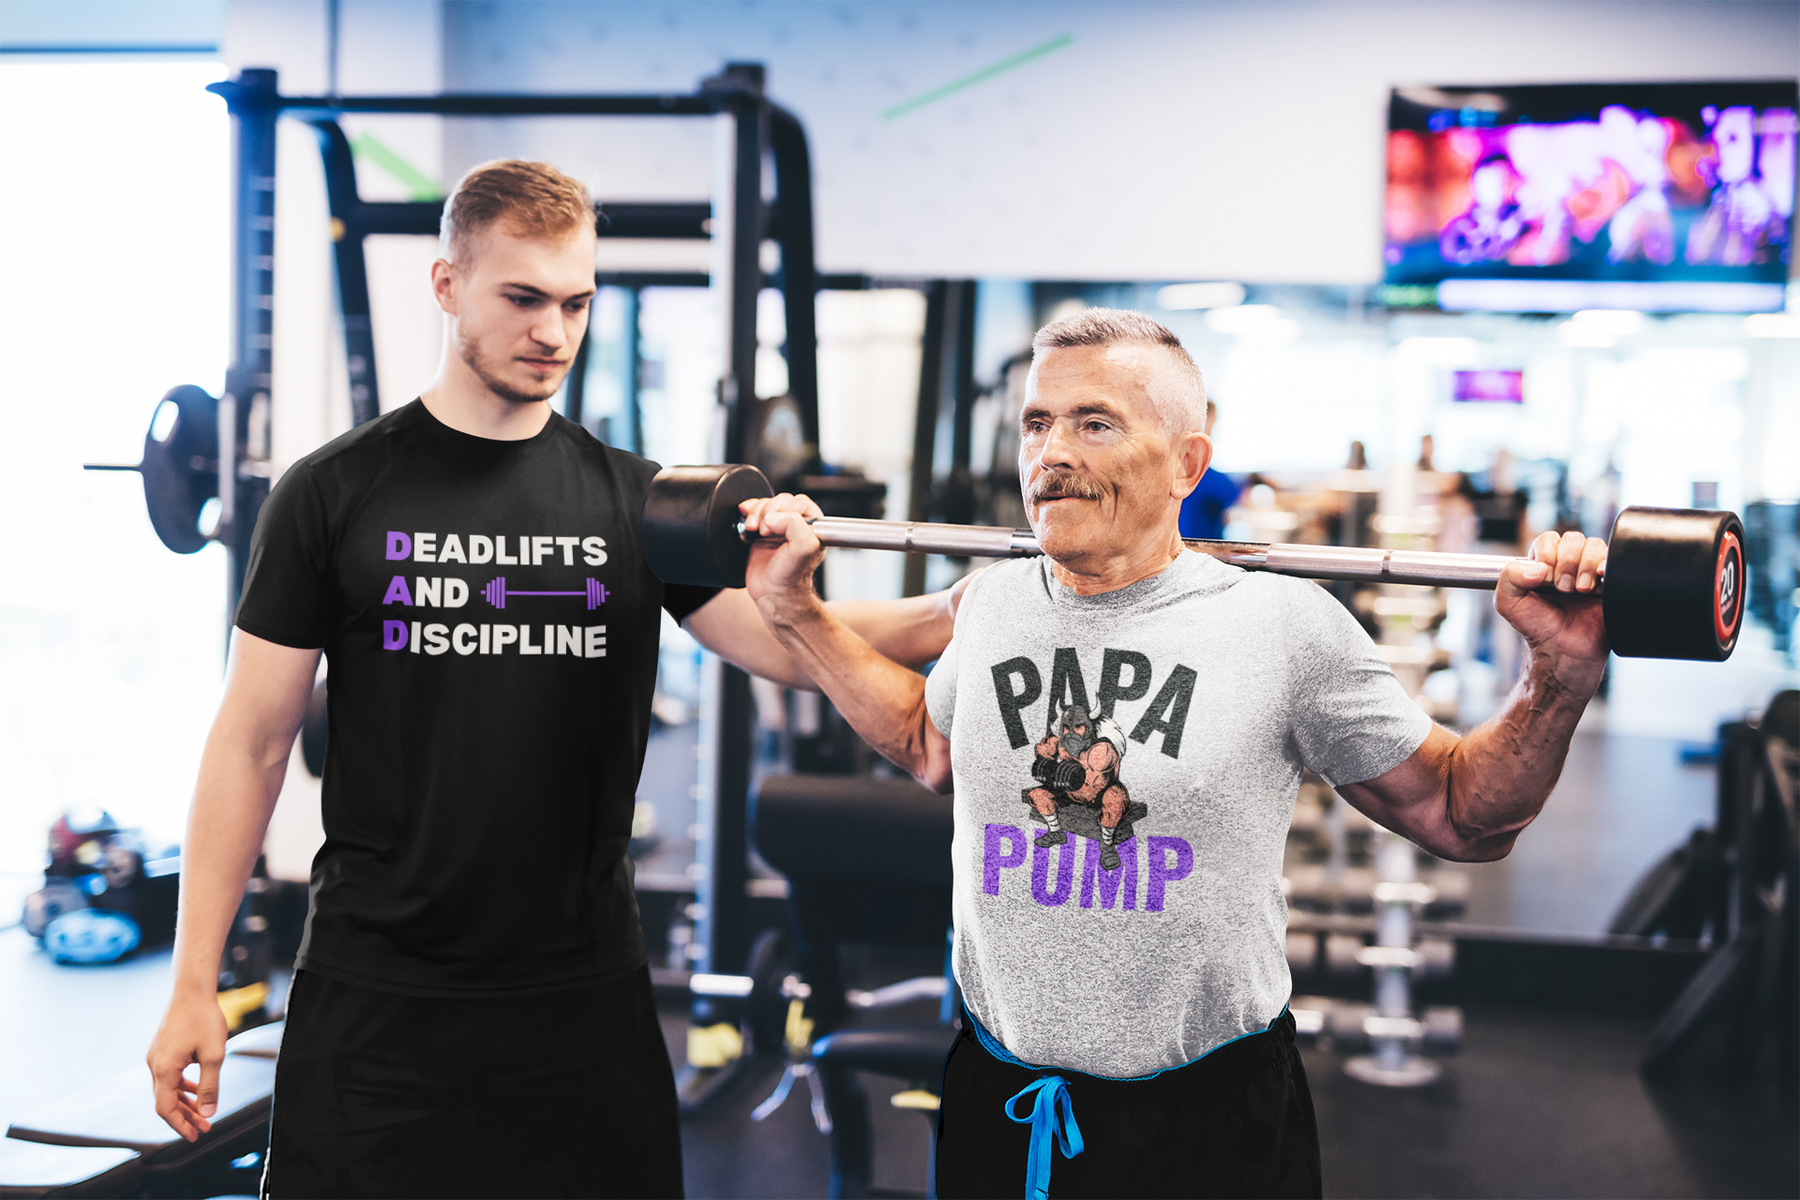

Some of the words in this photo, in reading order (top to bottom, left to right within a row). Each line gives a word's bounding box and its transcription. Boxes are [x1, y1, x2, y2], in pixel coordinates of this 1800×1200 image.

[385, 531, 608, 566] DEADLIFTS
[382, 575, 469, 608] AND
[1720, 561, 1734, 605] 20
[383, 619, 607, 658] DISCIPLINE
[991, 647, 1198, 760] PAPA
[982, 823, 1194, 912] PUMP
